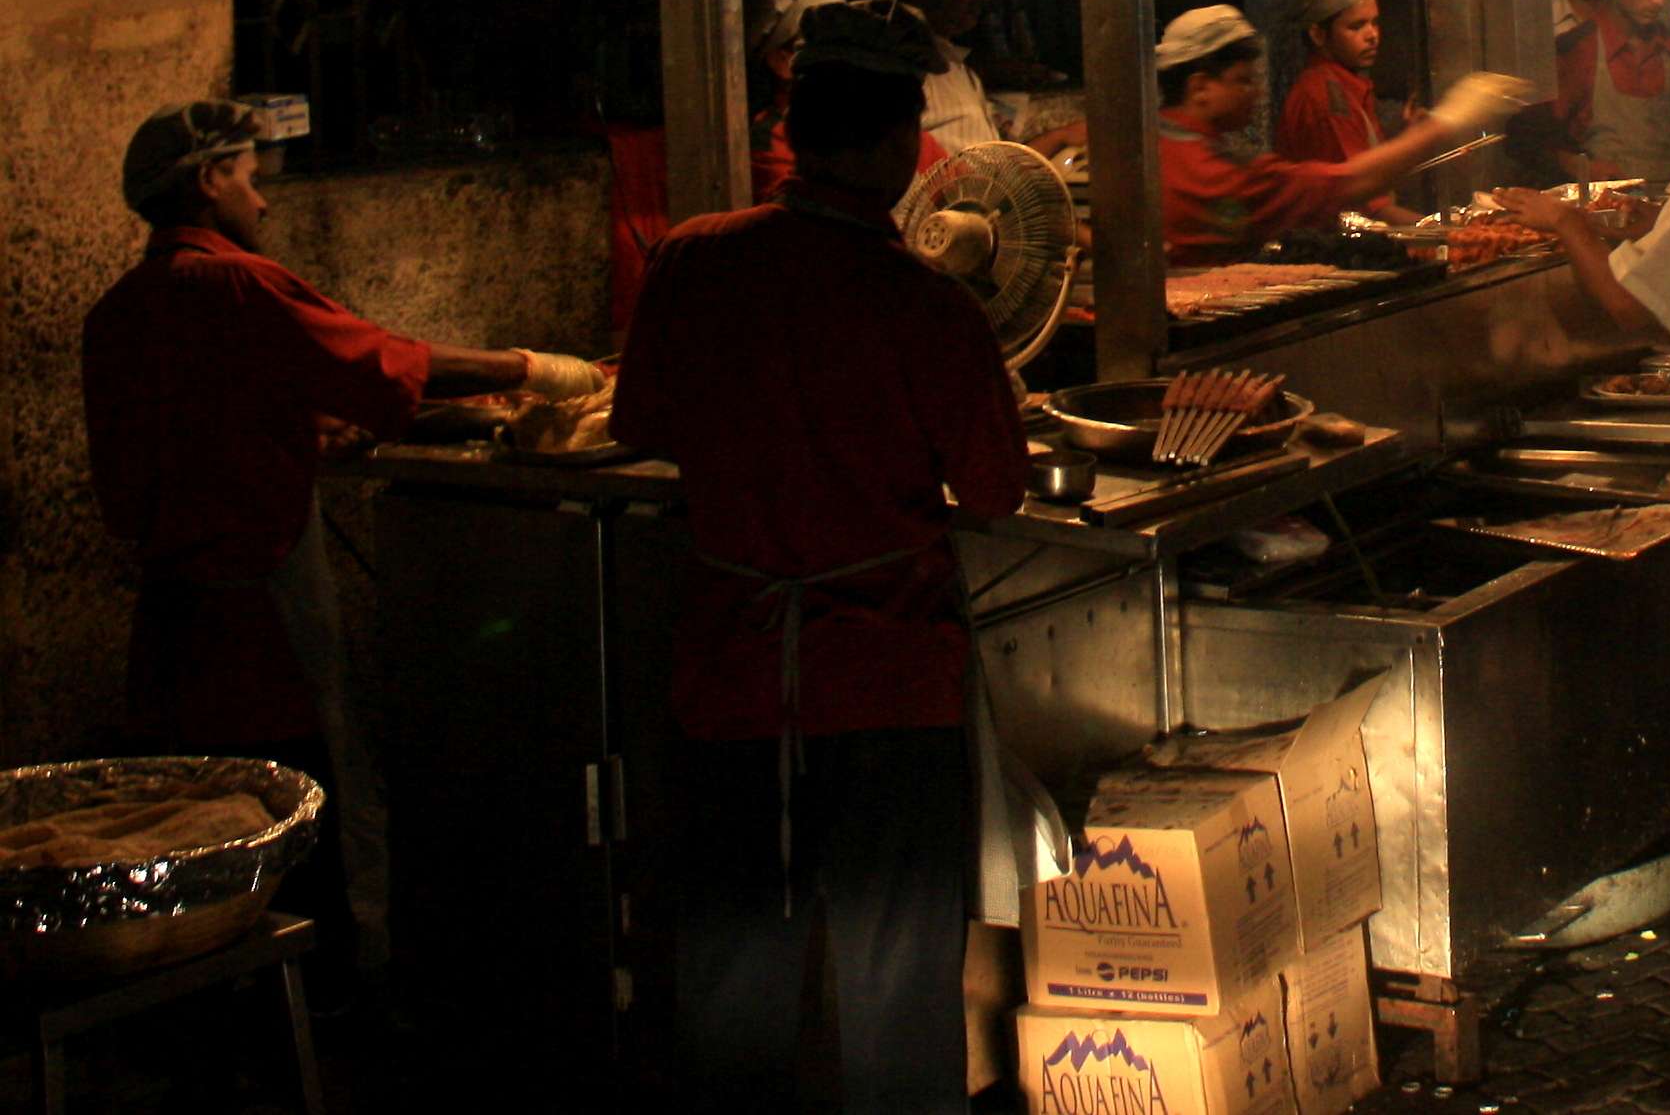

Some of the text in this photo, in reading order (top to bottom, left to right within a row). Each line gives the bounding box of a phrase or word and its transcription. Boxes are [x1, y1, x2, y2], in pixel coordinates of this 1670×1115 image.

[1045, 868, 1179, 934] AQUAFINA
[1118, 965, 1169, 982] PEPSI
[1041, 1052, 1169, 1115] AQUAFINA
